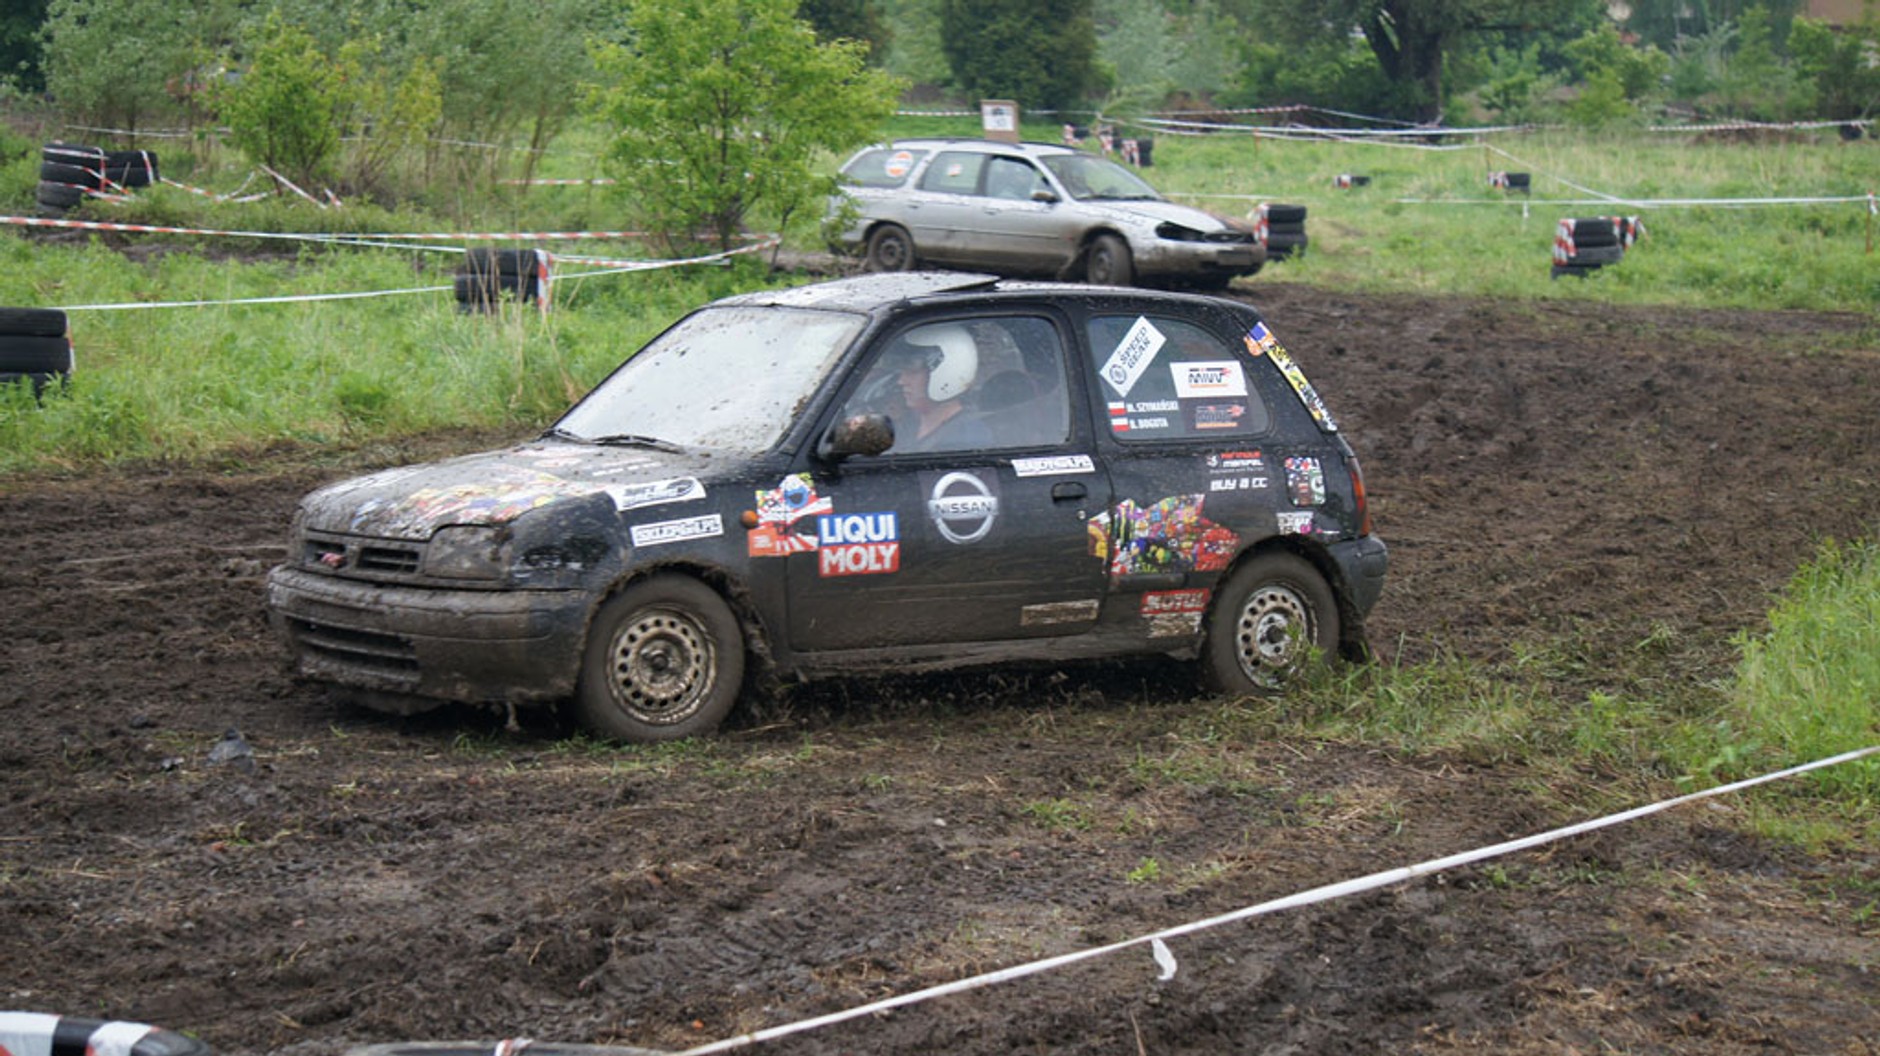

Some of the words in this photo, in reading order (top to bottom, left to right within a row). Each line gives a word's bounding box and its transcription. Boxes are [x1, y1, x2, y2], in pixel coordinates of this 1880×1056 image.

[1119, 326, 1149, 365] SPEED
[1127, 338, 1152, 370] GEAR
[935, 501, 992, 515] NISSAN
[820, 513, 896, 544] LIQUI
[822, 543, 899, 575] MOLY
